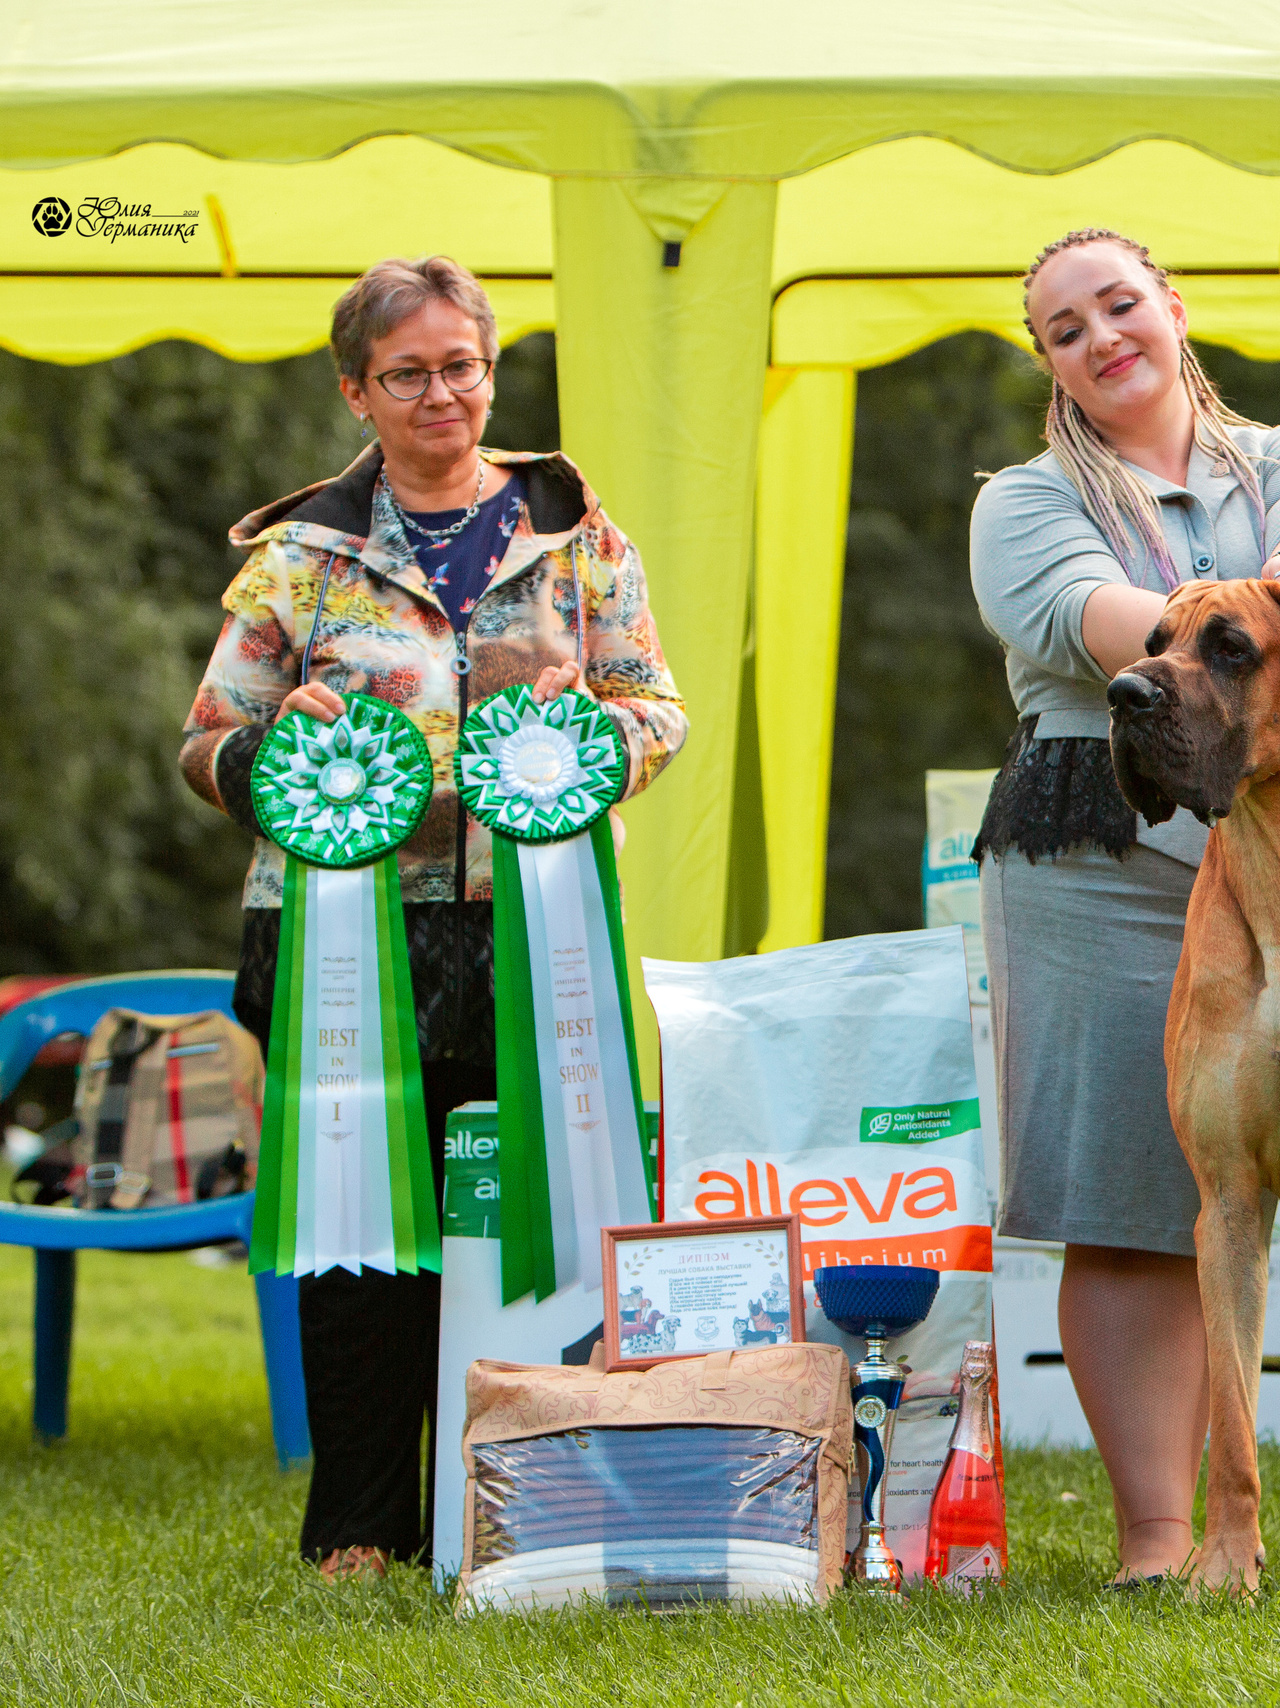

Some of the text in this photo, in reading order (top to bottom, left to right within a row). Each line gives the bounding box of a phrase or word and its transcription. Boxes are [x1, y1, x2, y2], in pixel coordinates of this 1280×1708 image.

[556, 1017, 594, 1039] BEST
[318, 1028, 359, 1047] BEST
[570, 1046, 583, 1057] IN
[331, 1056, 344, 1067] IN
[559, 1062, 599, 1085] SHOW
[316, 1073, 359, 1093] SHOW
[332, 1101, 341, 1122] I
[575, 1093, 591, 1114] II
[893, 1108, 951, 1122] Only Natural
[892, 1119, 952, 1131] Antioxidants
[907, 1129, 941, 1140] Added
[694, 1158, 958, 1228] alleva
[658, 1263, 752, 1276] ЛУЧШАЯ СОБАКА ВЫСТАВКИ
[890, 1460, 901, 1468] for
[902, 1460, 921, 1468] heart
